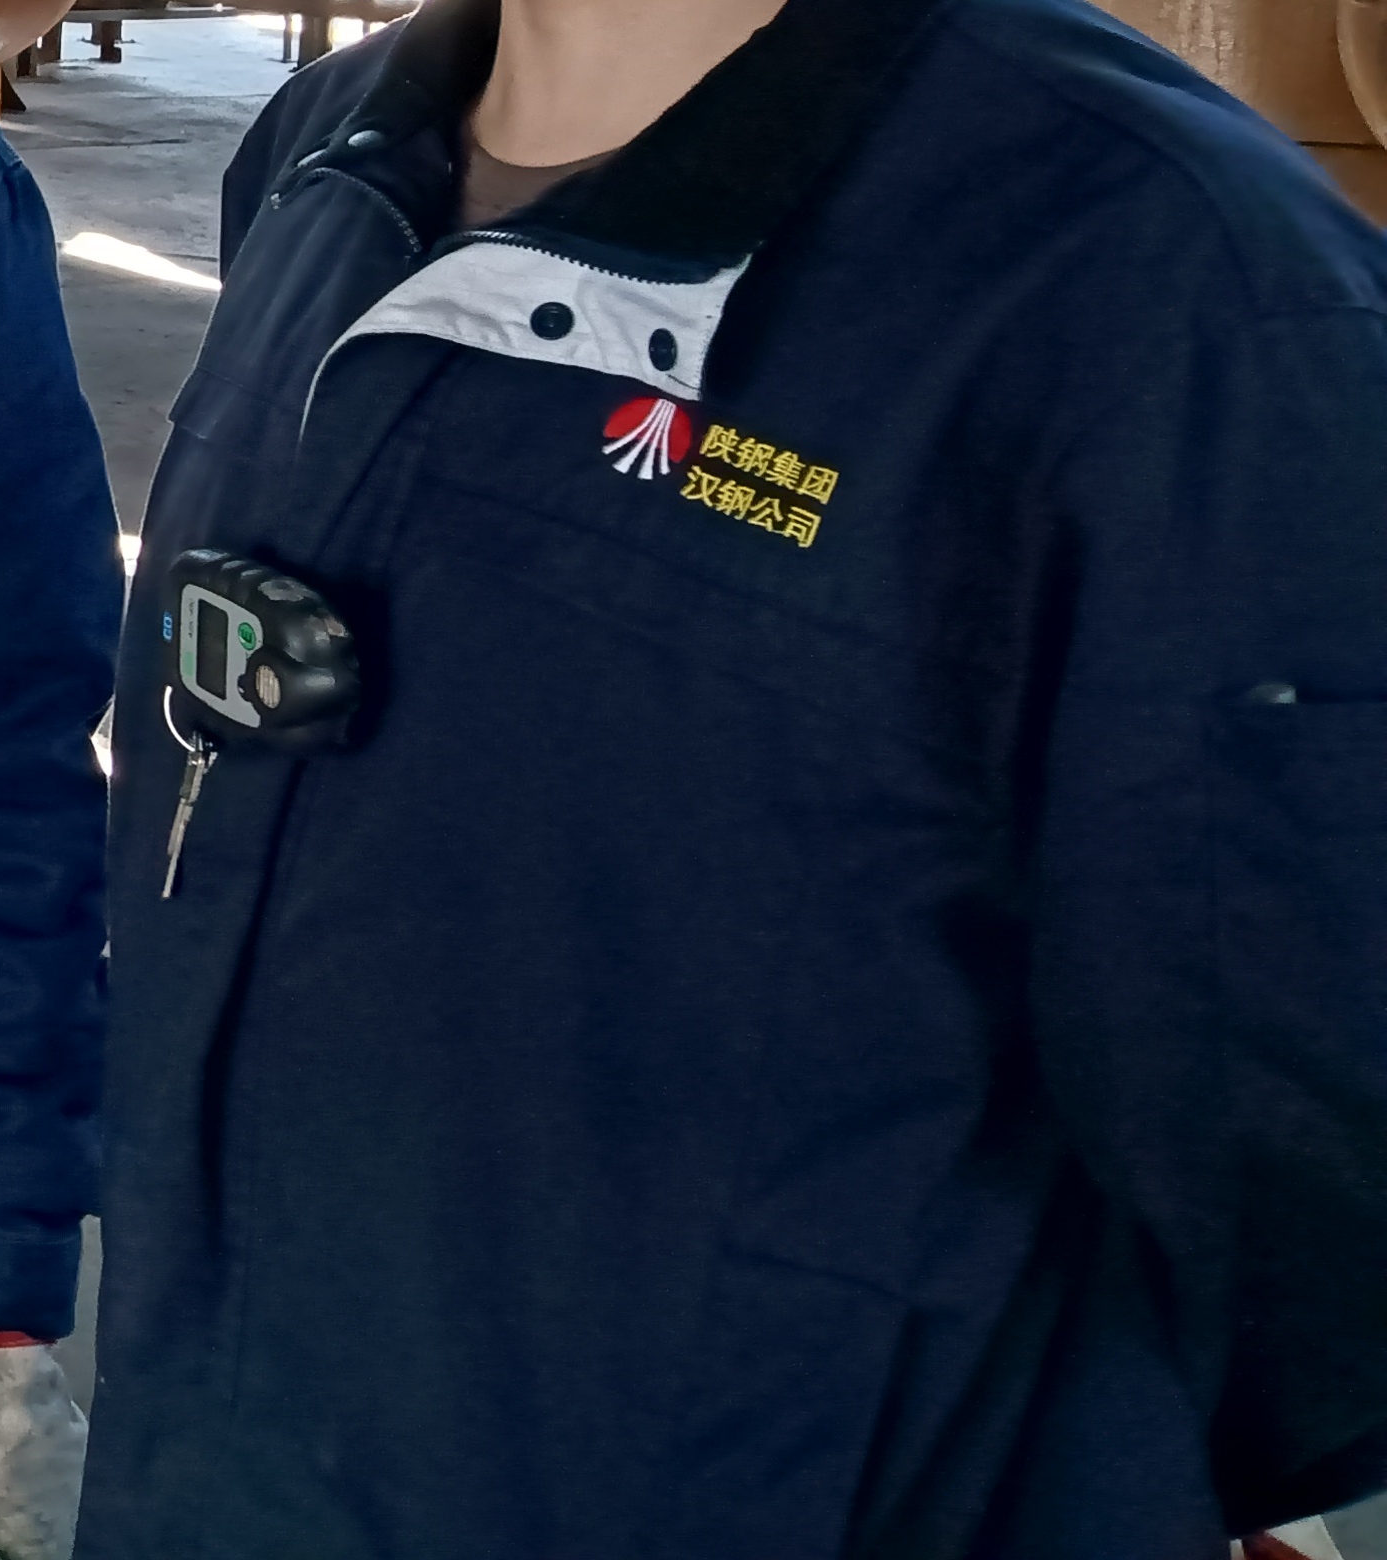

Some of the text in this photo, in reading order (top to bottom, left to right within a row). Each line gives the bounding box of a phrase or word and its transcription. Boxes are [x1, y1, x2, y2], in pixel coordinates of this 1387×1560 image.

[699, 424, 840, 505] 陕钢集团
[680, 465, 822, 548] 汉钢公司
